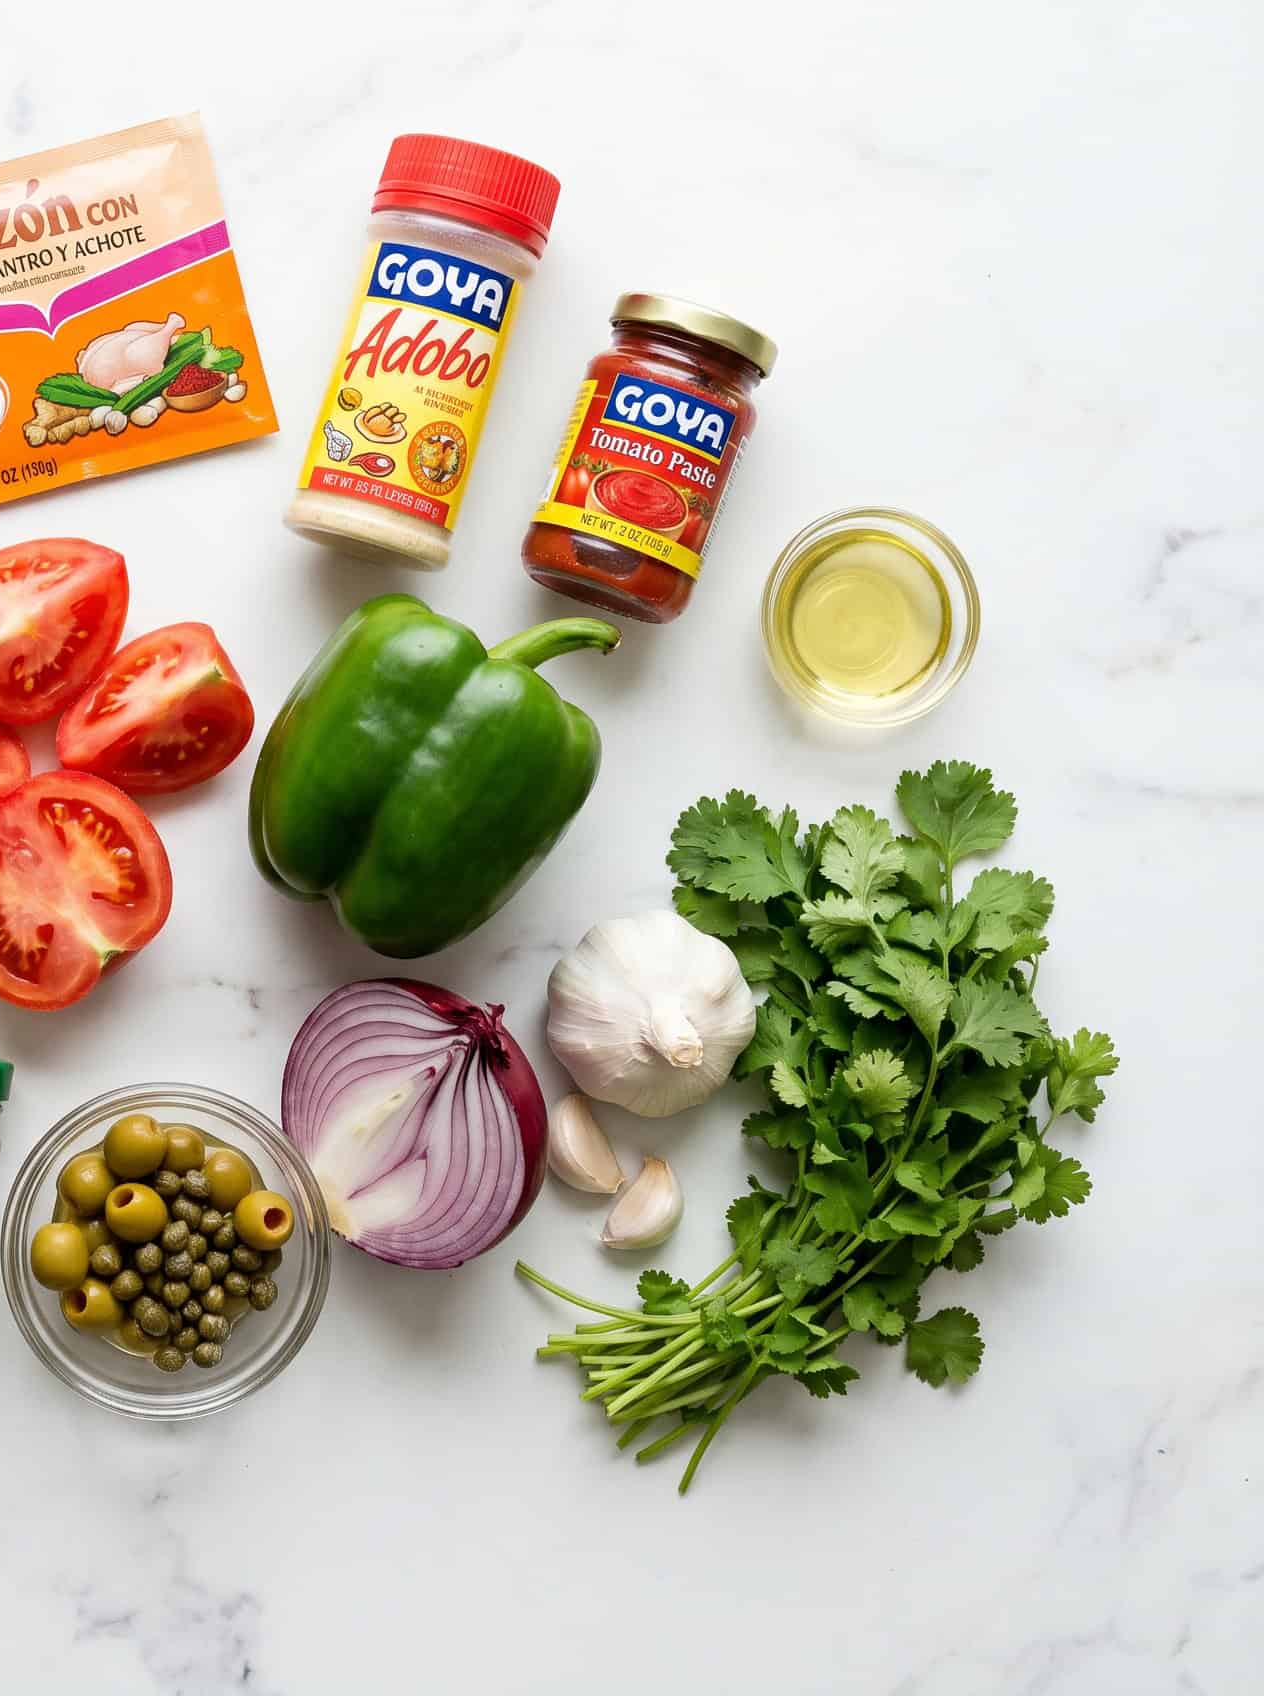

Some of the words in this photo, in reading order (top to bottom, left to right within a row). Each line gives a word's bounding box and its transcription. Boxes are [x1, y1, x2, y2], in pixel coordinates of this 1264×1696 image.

[86, 193, 139, 226] CON
[56, 244, 68, 262] Y
[75, 225, 147, 259] ACHOTE
[377, 252, 505, 322] GOYA
[343, 308, 491, 388] Adobo
[615, 385, 725, 451] GOYA
[1, 467, 20, 485] OZ
[589, 427, 665, 466] Tomato
[667, 450, 717, 489] Paste
[580, 512, 600, 528] NET
[599, 517, 616, 533] WT
